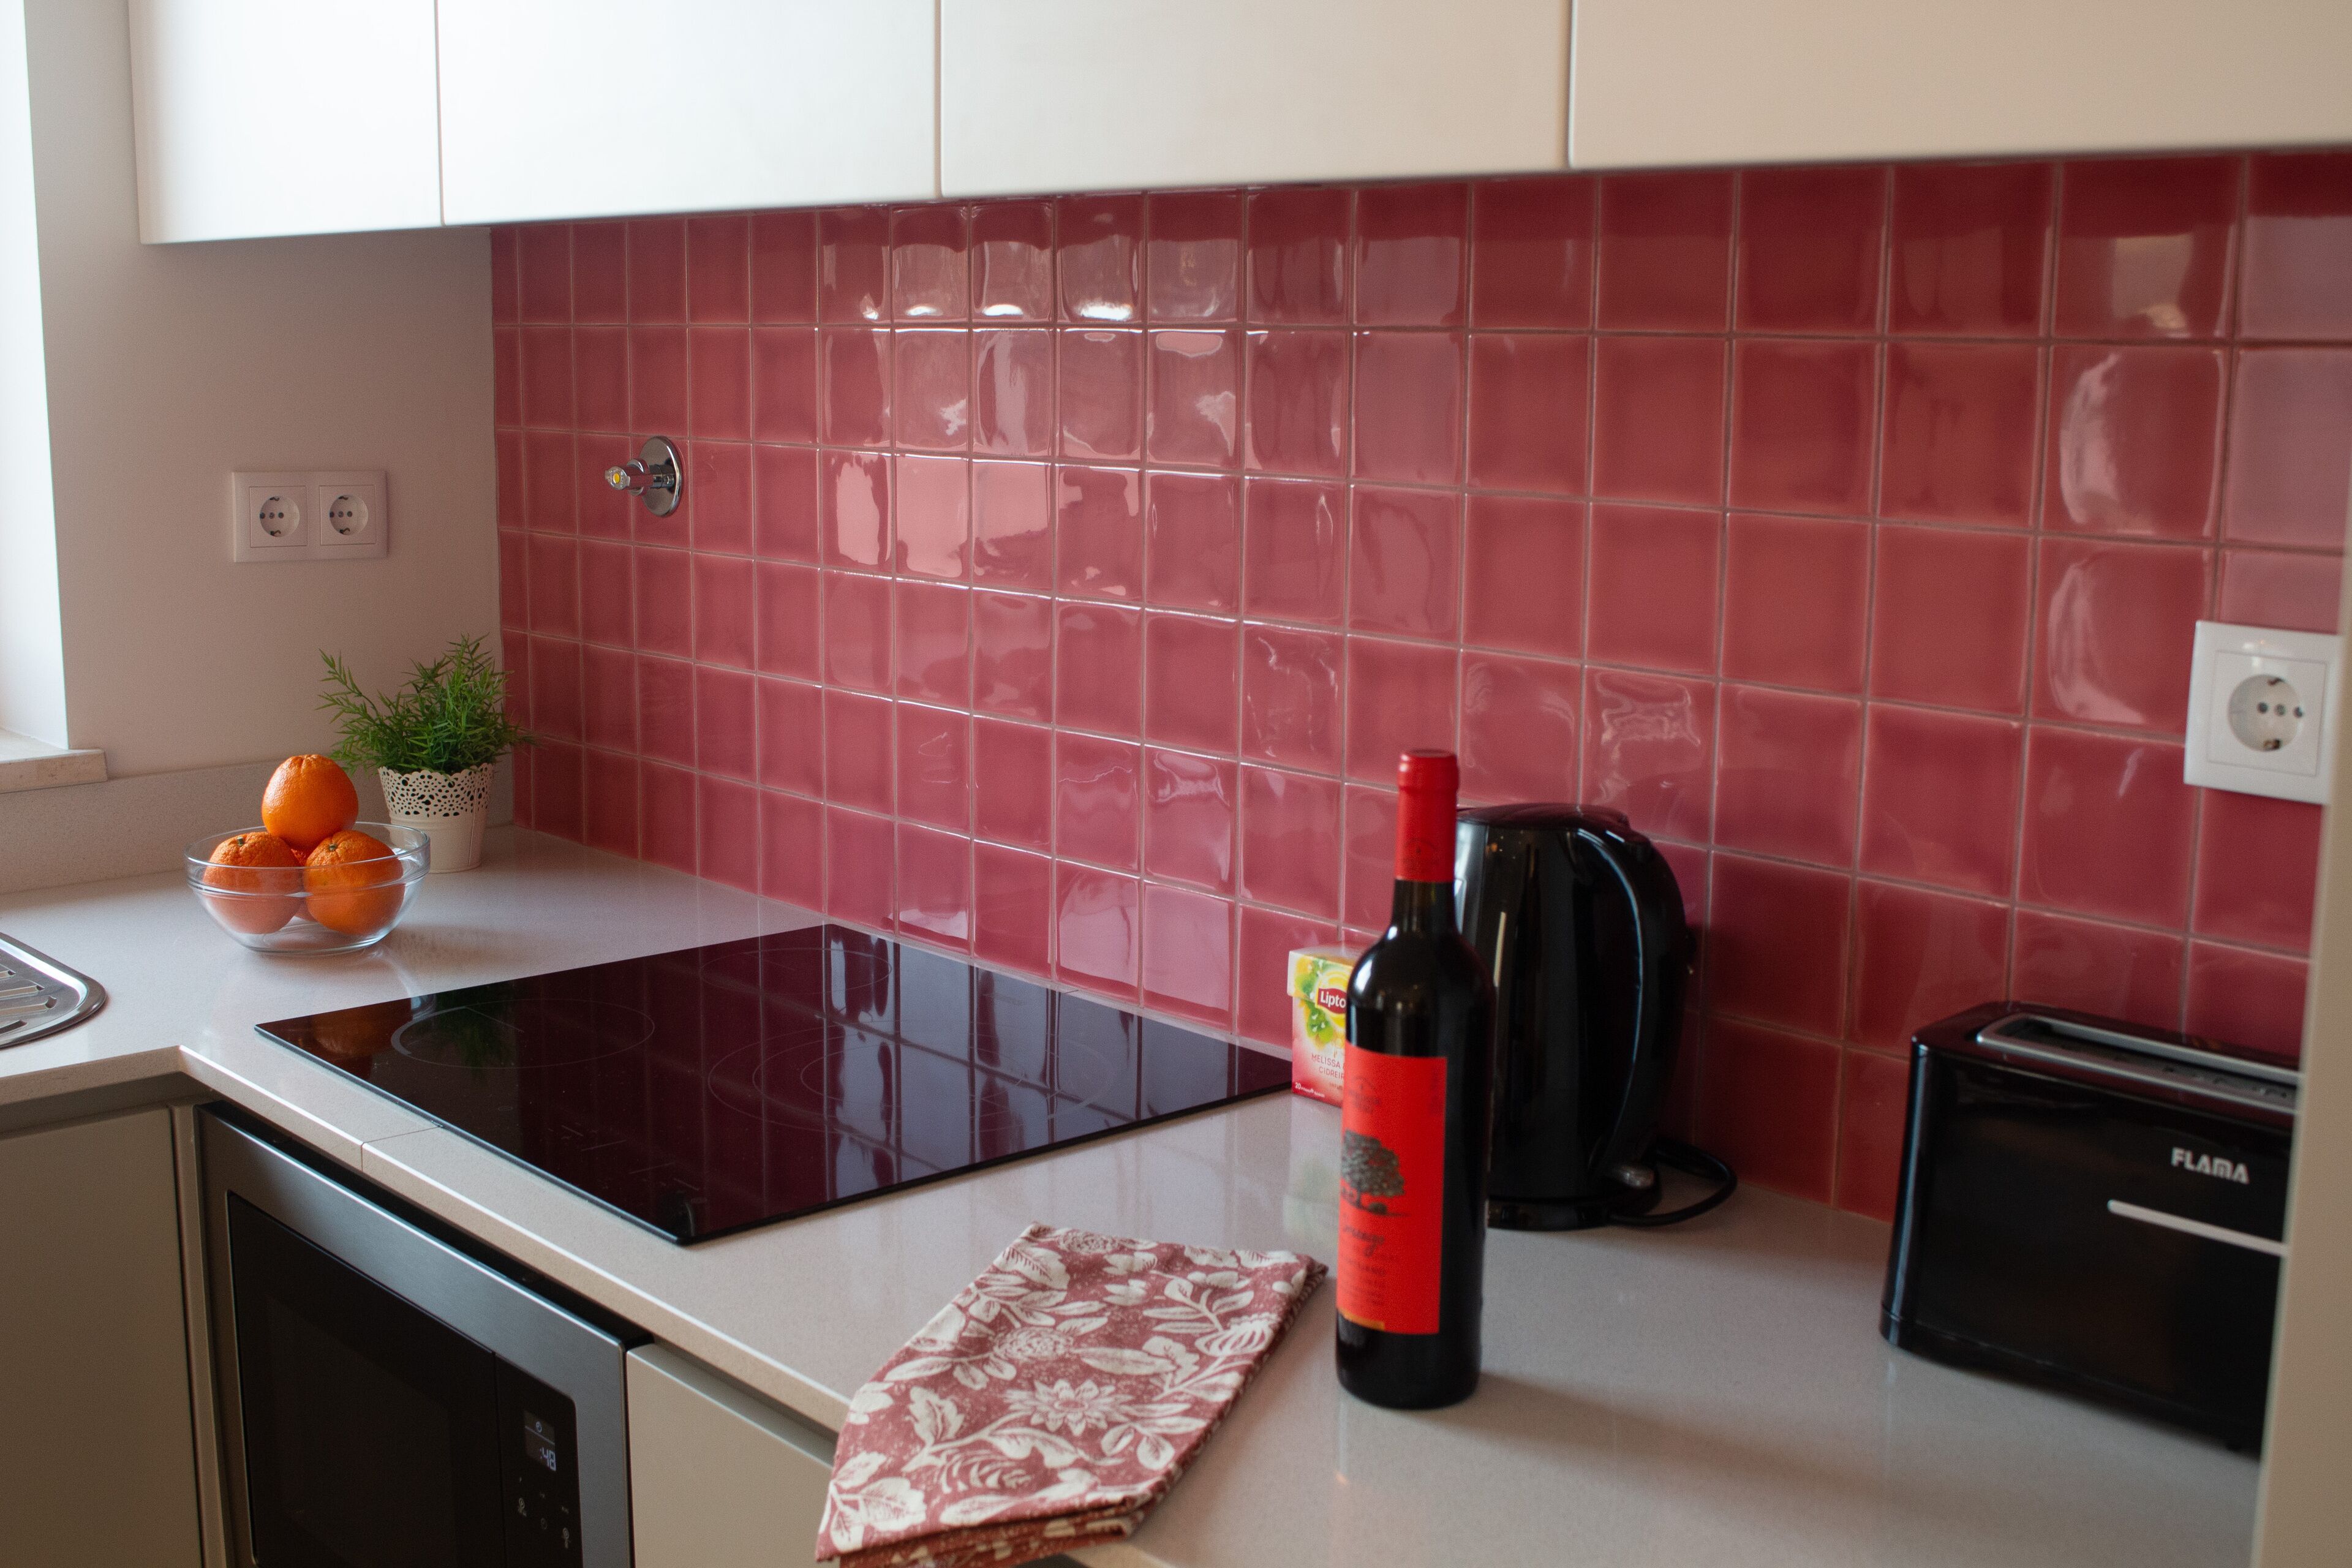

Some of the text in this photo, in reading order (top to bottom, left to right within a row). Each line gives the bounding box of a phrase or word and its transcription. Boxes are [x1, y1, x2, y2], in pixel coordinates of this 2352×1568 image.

[1321, 991, 1346, 1009] Lipto
[1311, 1054, 1341, 1069] MELISSA
[1319, 1066, 1344, 1079] CIDREIR
[2171, 1147, 2250, 1185] FLAMA
